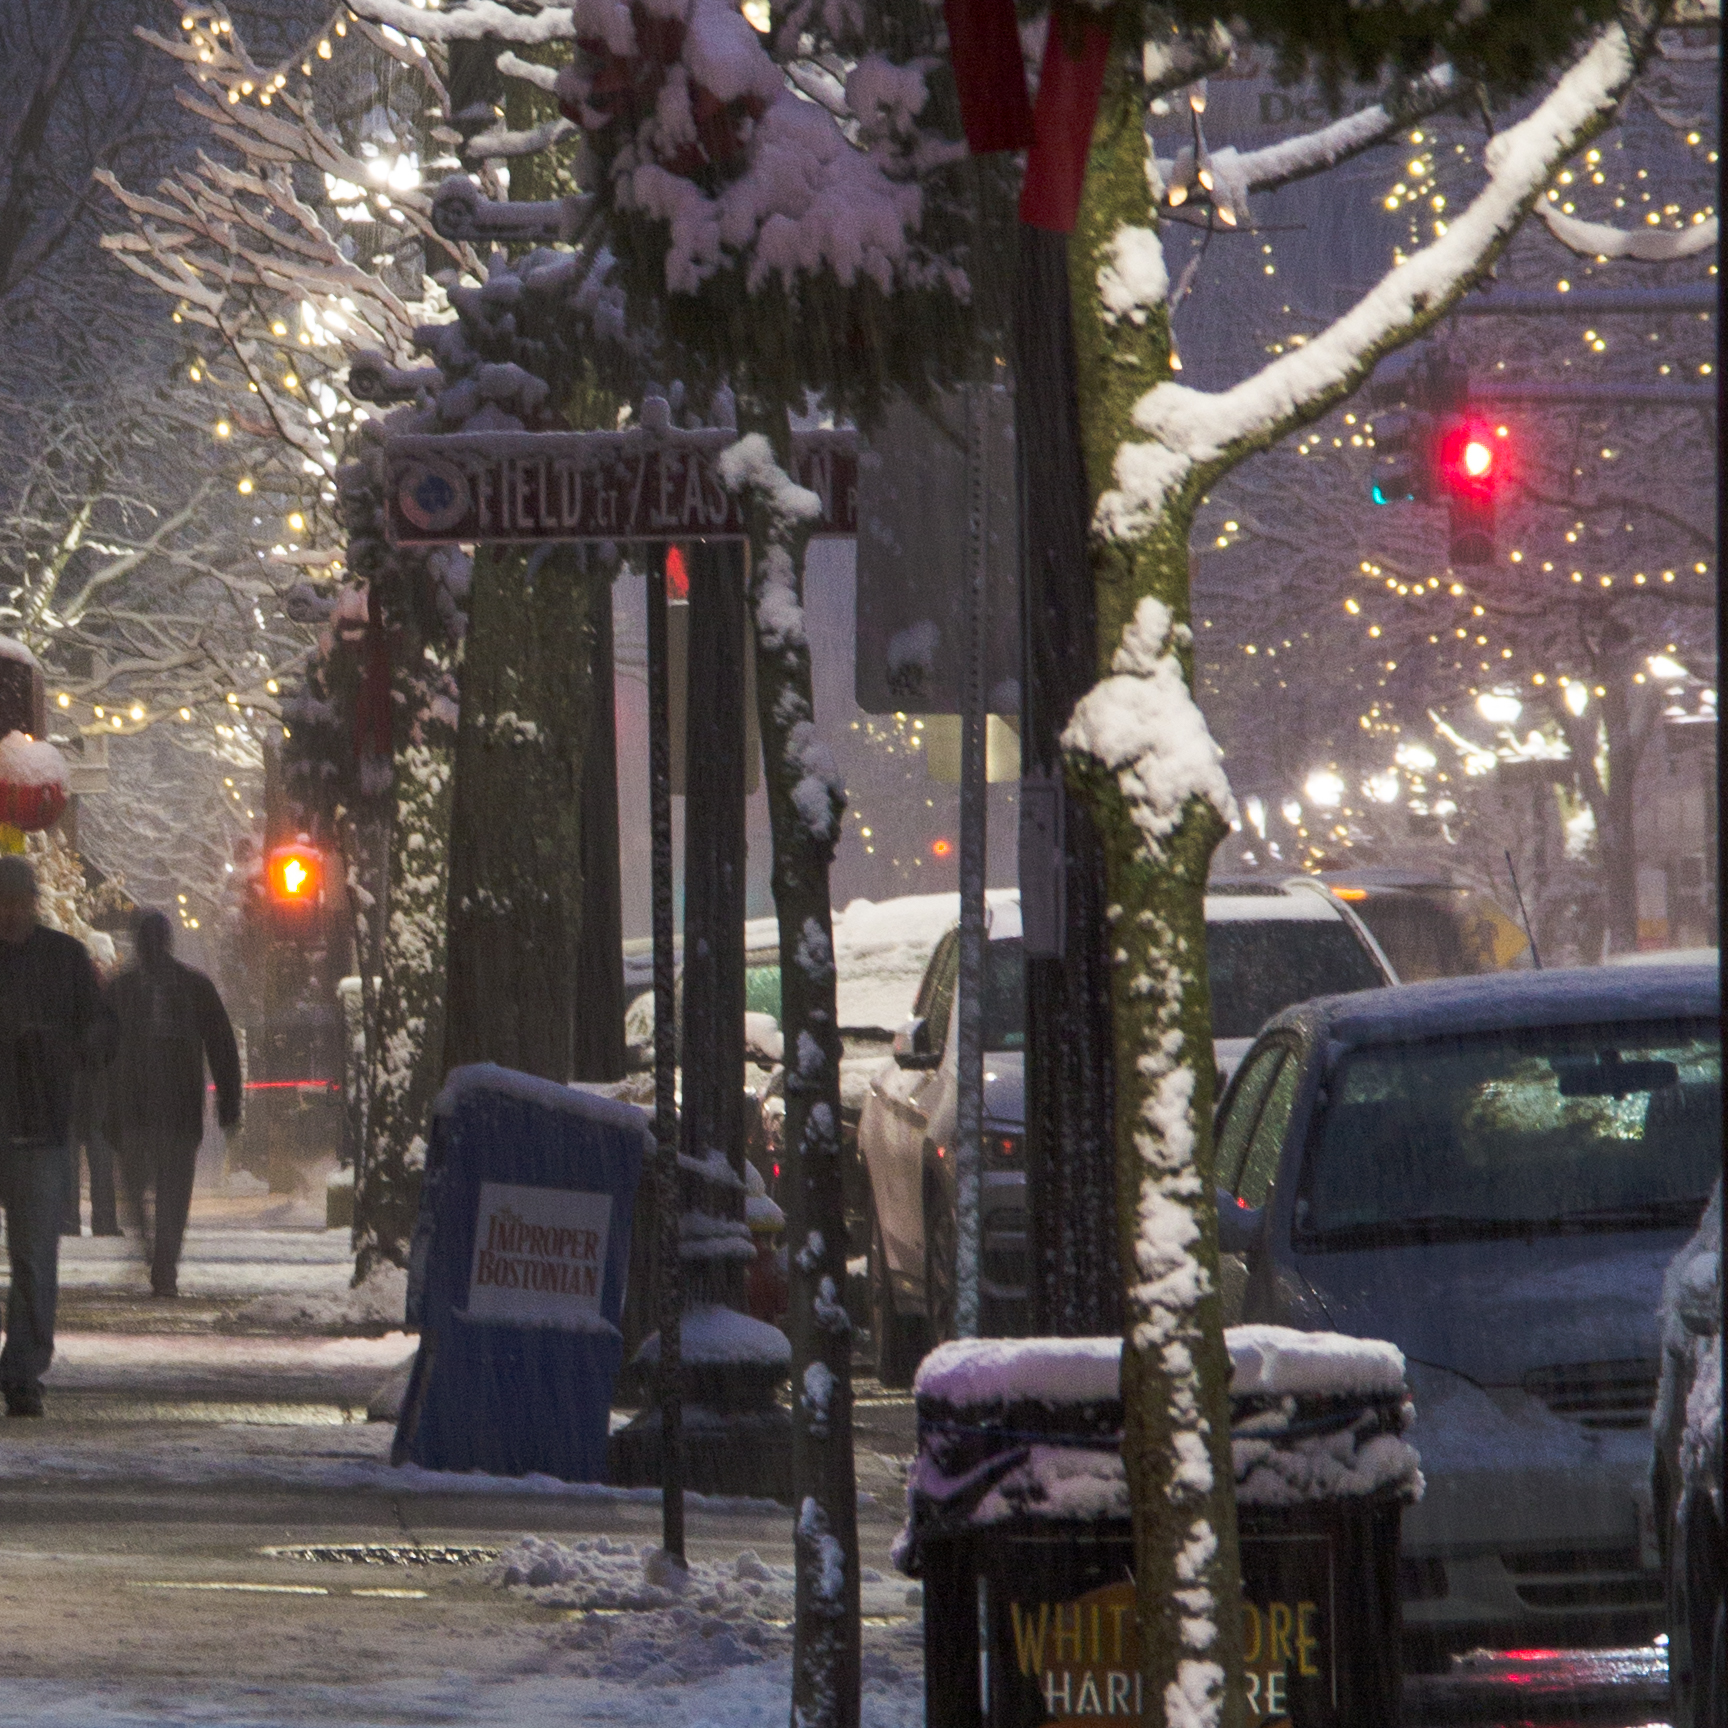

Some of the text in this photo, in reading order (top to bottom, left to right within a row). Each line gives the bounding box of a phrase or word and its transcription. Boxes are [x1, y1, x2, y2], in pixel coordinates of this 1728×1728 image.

[478, 458, 582, 529] FIELD
[486, 1214, 600, 1261] IMPROPER
[476, 1249, 599, 1297] BOSTONIAN
